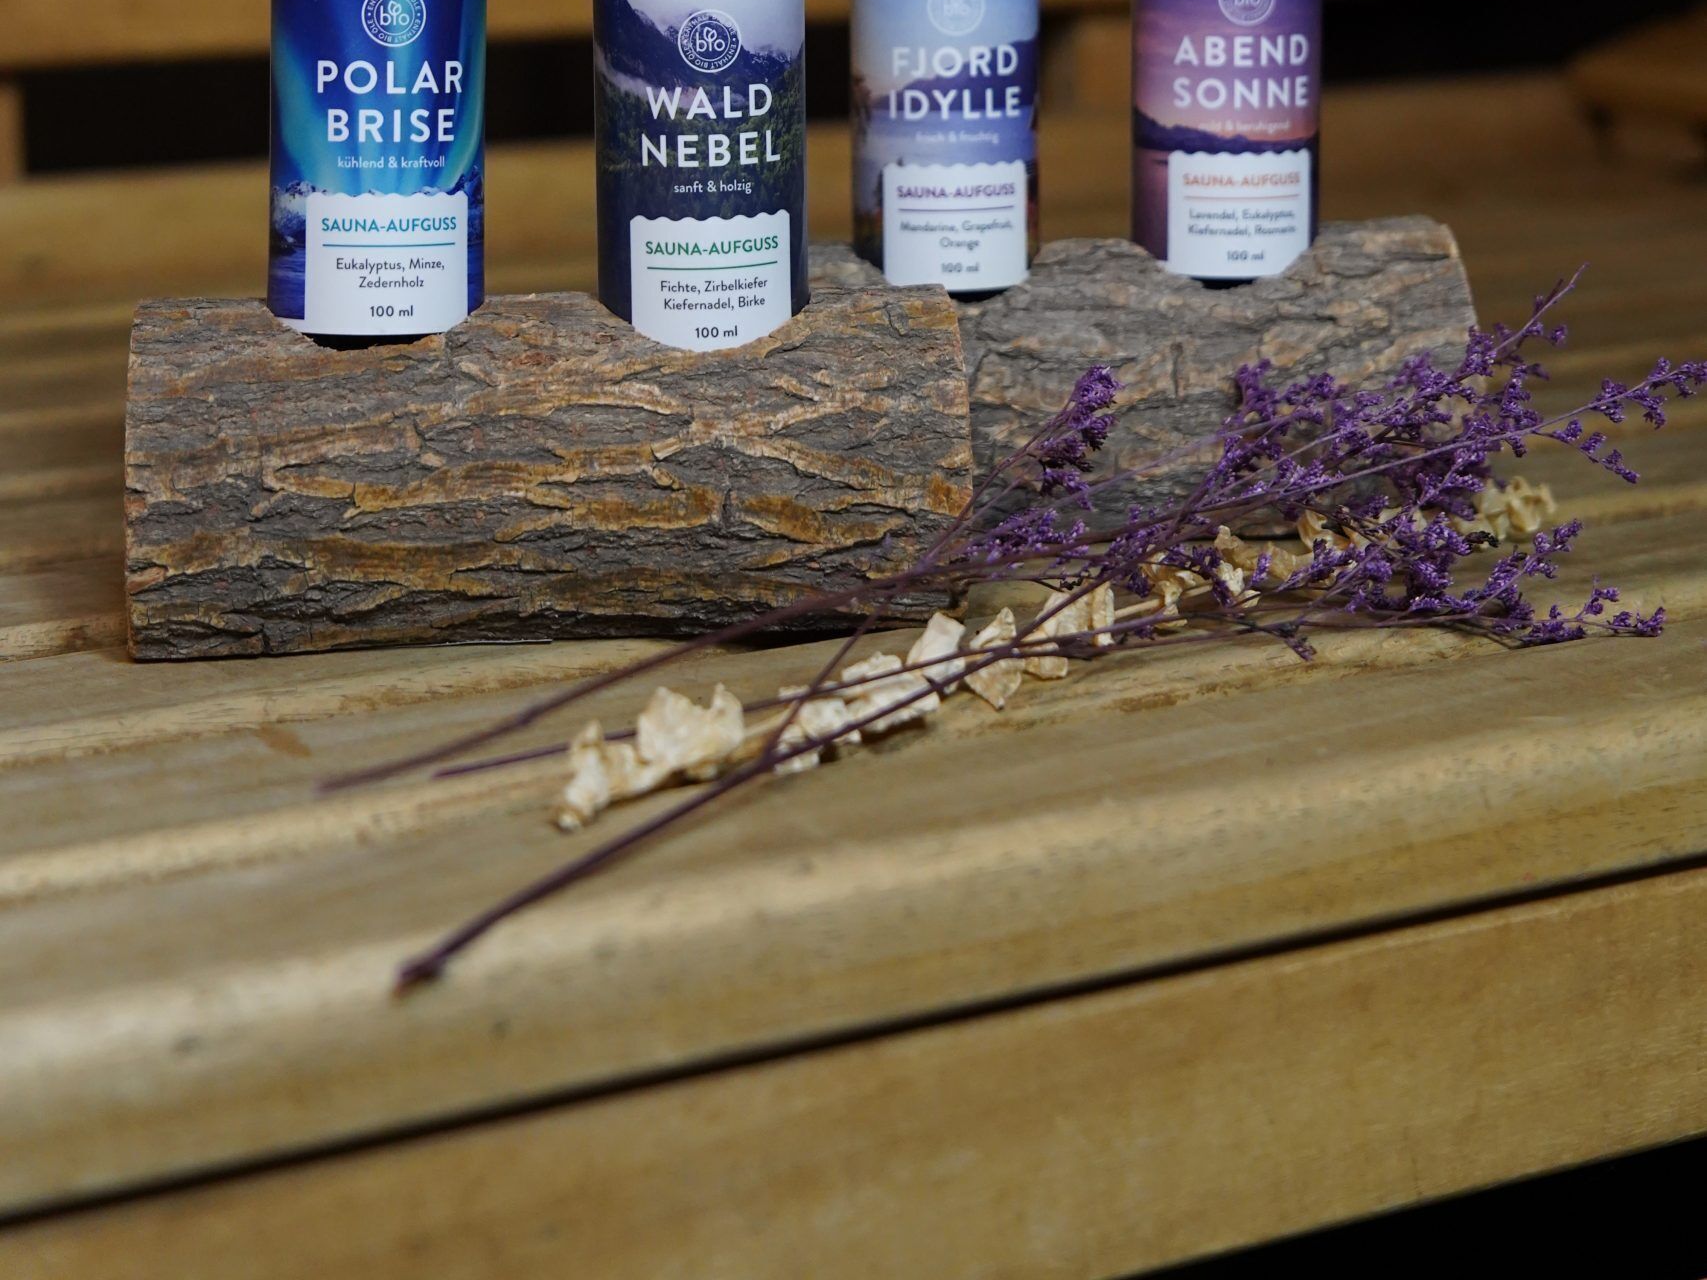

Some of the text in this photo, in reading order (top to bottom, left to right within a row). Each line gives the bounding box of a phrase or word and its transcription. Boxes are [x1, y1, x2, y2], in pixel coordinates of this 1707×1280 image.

[1173, 33, 1310, 68] ABEND
[891, 43, 1019, 78] FJORD
[316, 59, 464, 95] POLAR
[645, 82, 773, 120] WALD
[1173, 75, 1311, 110] SONNE
[889, 85, 1022, 120] IDYLLE
[326, 108, 456, 143] BRISE
[641, 129, 781, 168] NEBEL
[337, 155, 446, 169] kühlend & kraftvoll
[673, 179, 752, 195] sanft & holzig
[1182, 172, 1302, 188] SAUNA-AUFGUSS
[896, 182, 1016, 199] SAUNA-AUFGUSS
[321, 216, 457, 233] SAUNA-AUFGUSS
[645, 235, 779, 256] SAUNA-AUFGUSS
[939, 236, 980, 251] Orange
[1226, 249, 1248, 261] 100
[335, 257, 446, 274] Eukalyptus, Minze,
[941, 262, 962, 273] 100
[358, 275, 425, 289] Zedernholz
[660, 276, 768, 294] Fichte, Zirbelkiefer
[663, 294, 766, 311] Kiefernadel, Birke
[369, 305, 414, 318] 100 ml
[695, 325, 738, 339] 100 ml
